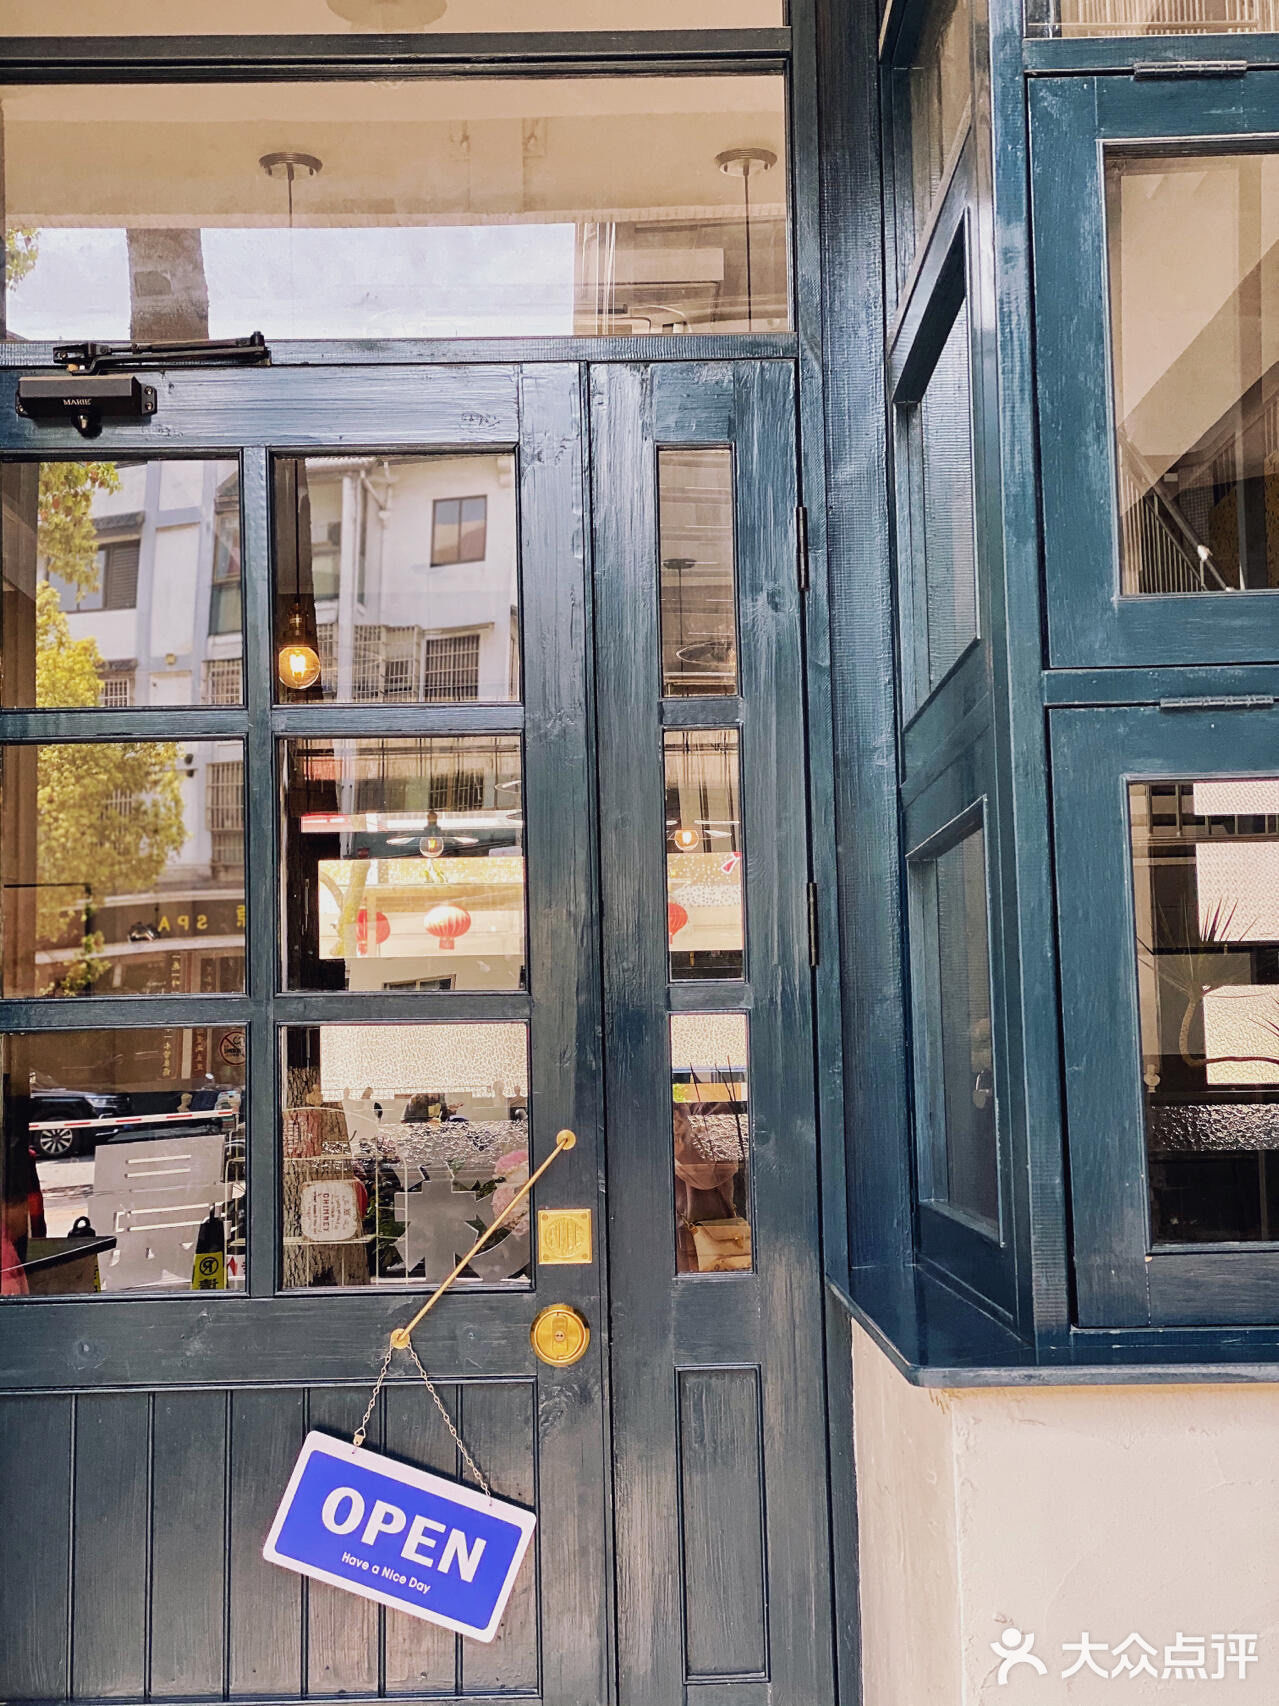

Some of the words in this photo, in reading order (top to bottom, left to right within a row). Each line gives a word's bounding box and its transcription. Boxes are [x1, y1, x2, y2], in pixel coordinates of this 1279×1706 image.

[321, 1486, 487, 1584] OPEN
[341, 1551, 370, 1571] Have
[371, 1564, 381, 1575] a
[381, 1566, 407, 1585] Nice
[408, 1576, 431, 1595] Day
